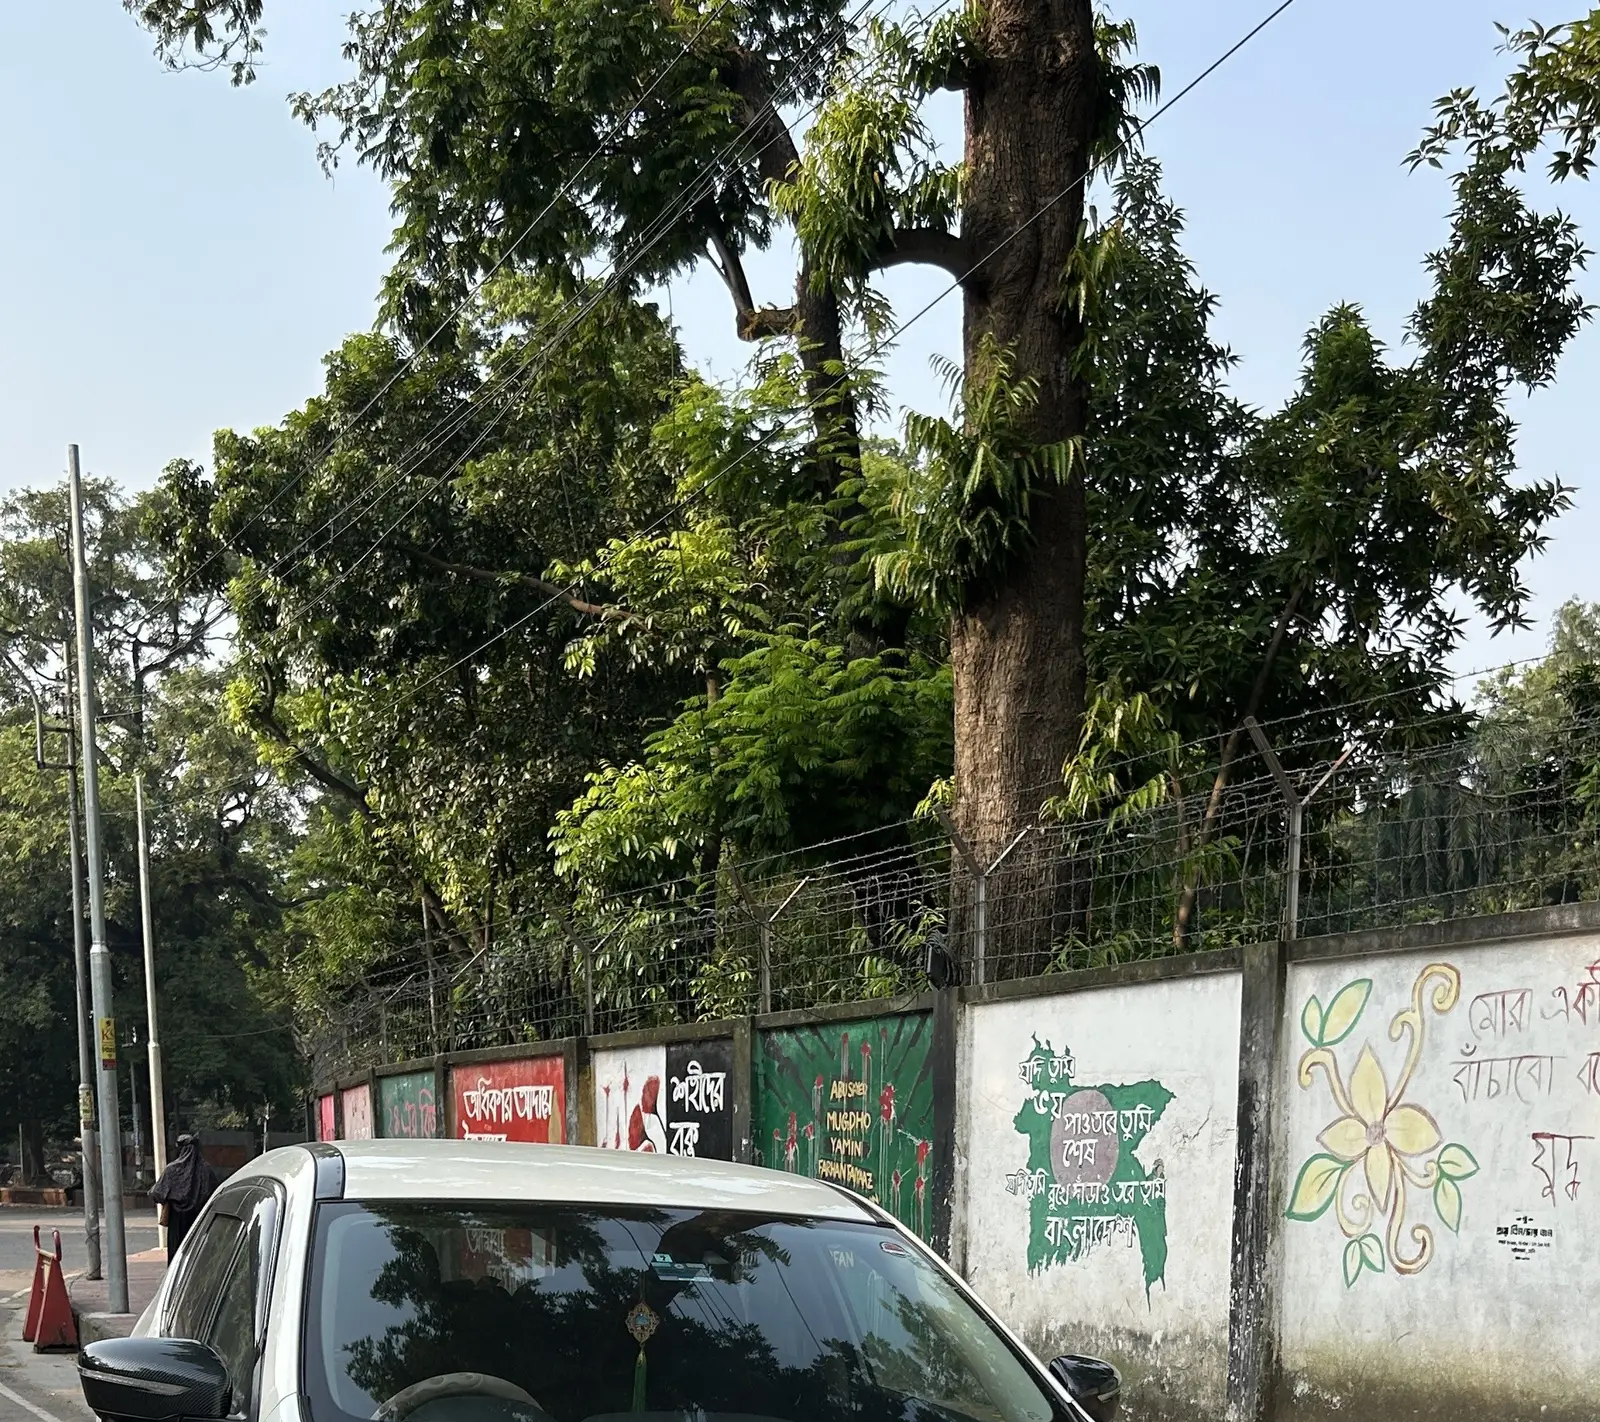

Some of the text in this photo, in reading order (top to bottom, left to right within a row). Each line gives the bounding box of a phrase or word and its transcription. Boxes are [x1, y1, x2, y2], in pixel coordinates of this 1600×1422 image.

[1540, 959, 1600, 1026] এক
[1018, 1054, 1076, 1084] যদি তুমি
[670, 1060, 726, 1113] শহীদের
[826, 1111, 872, 1132] MUGDHO
[1119, 1103, 1155, 1141] তুমি
[830, 1137, 862, 1157] YAMIN
[1062, 1139, 1098, 1167] শেষ
[1044, 1214, 1137, 1248] বাংলাদেশ
